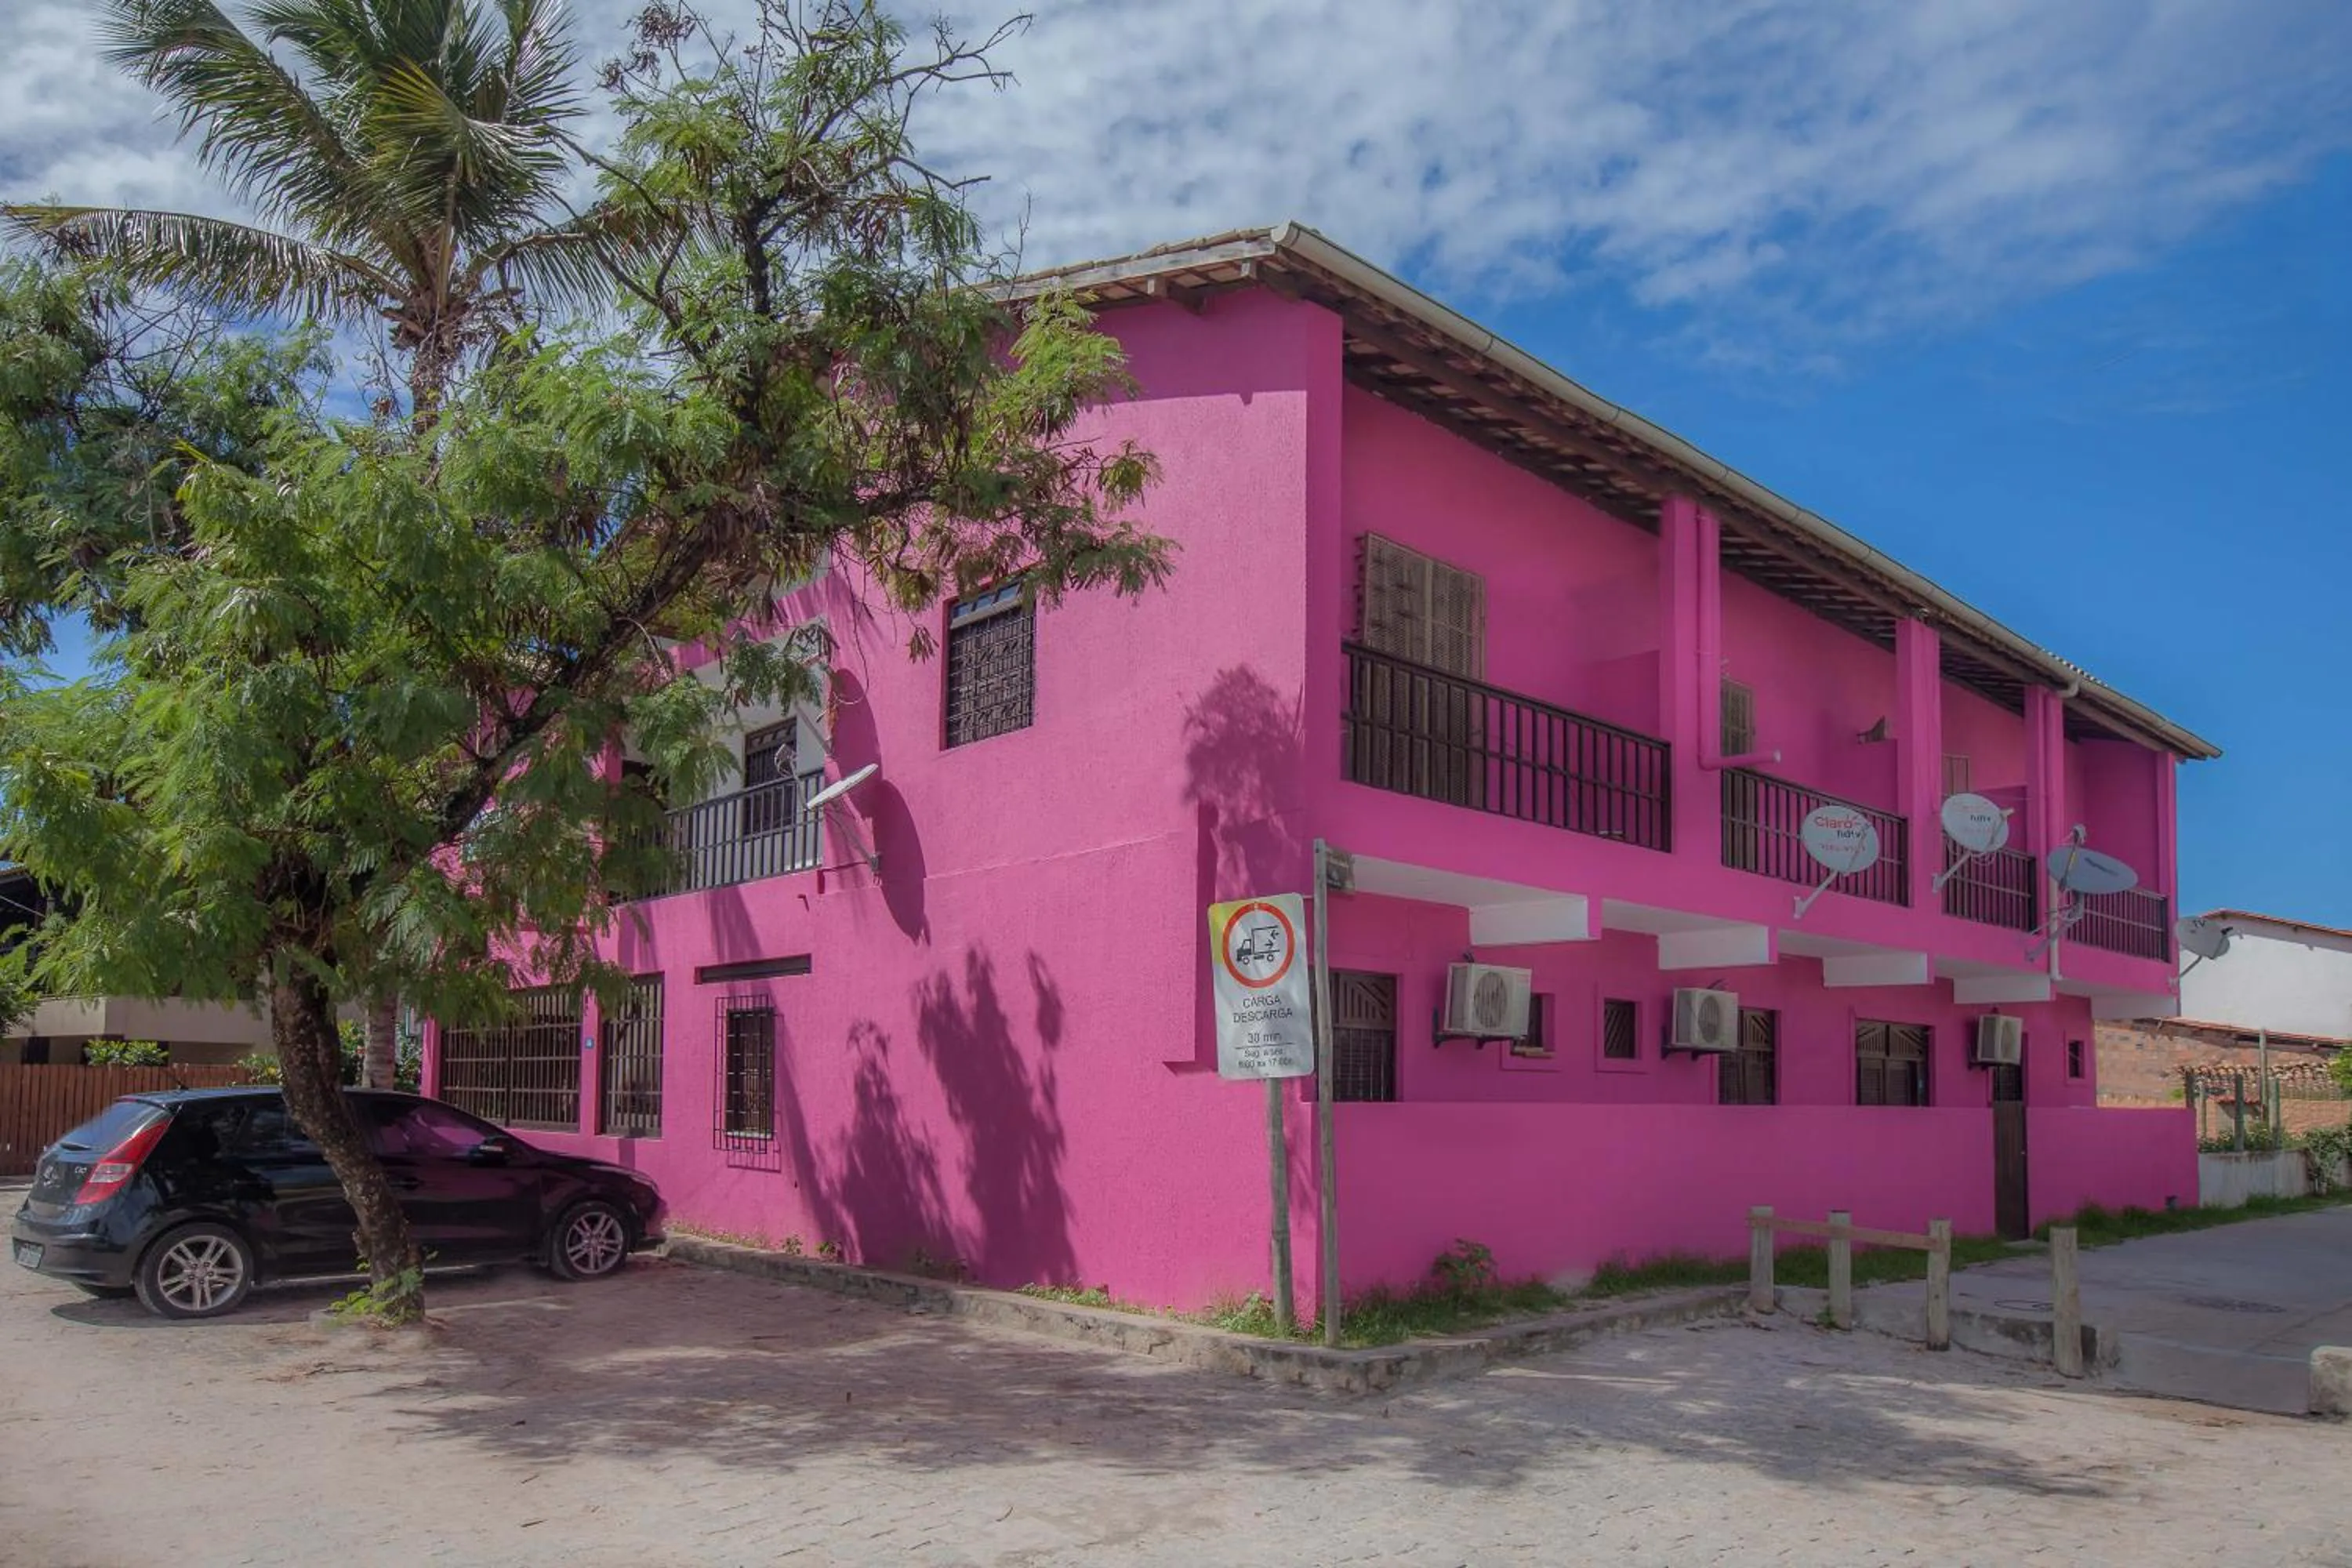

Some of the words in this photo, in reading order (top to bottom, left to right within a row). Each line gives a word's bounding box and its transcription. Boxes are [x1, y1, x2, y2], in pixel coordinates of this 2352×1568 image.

[1243, 994, 1282, 1009] CARGA
[1233, 1008, 1293, 1023] DESCARGA
[1247, 1033, 1260, 1044] 30
[1264, 1032, 1282, 1042] min
